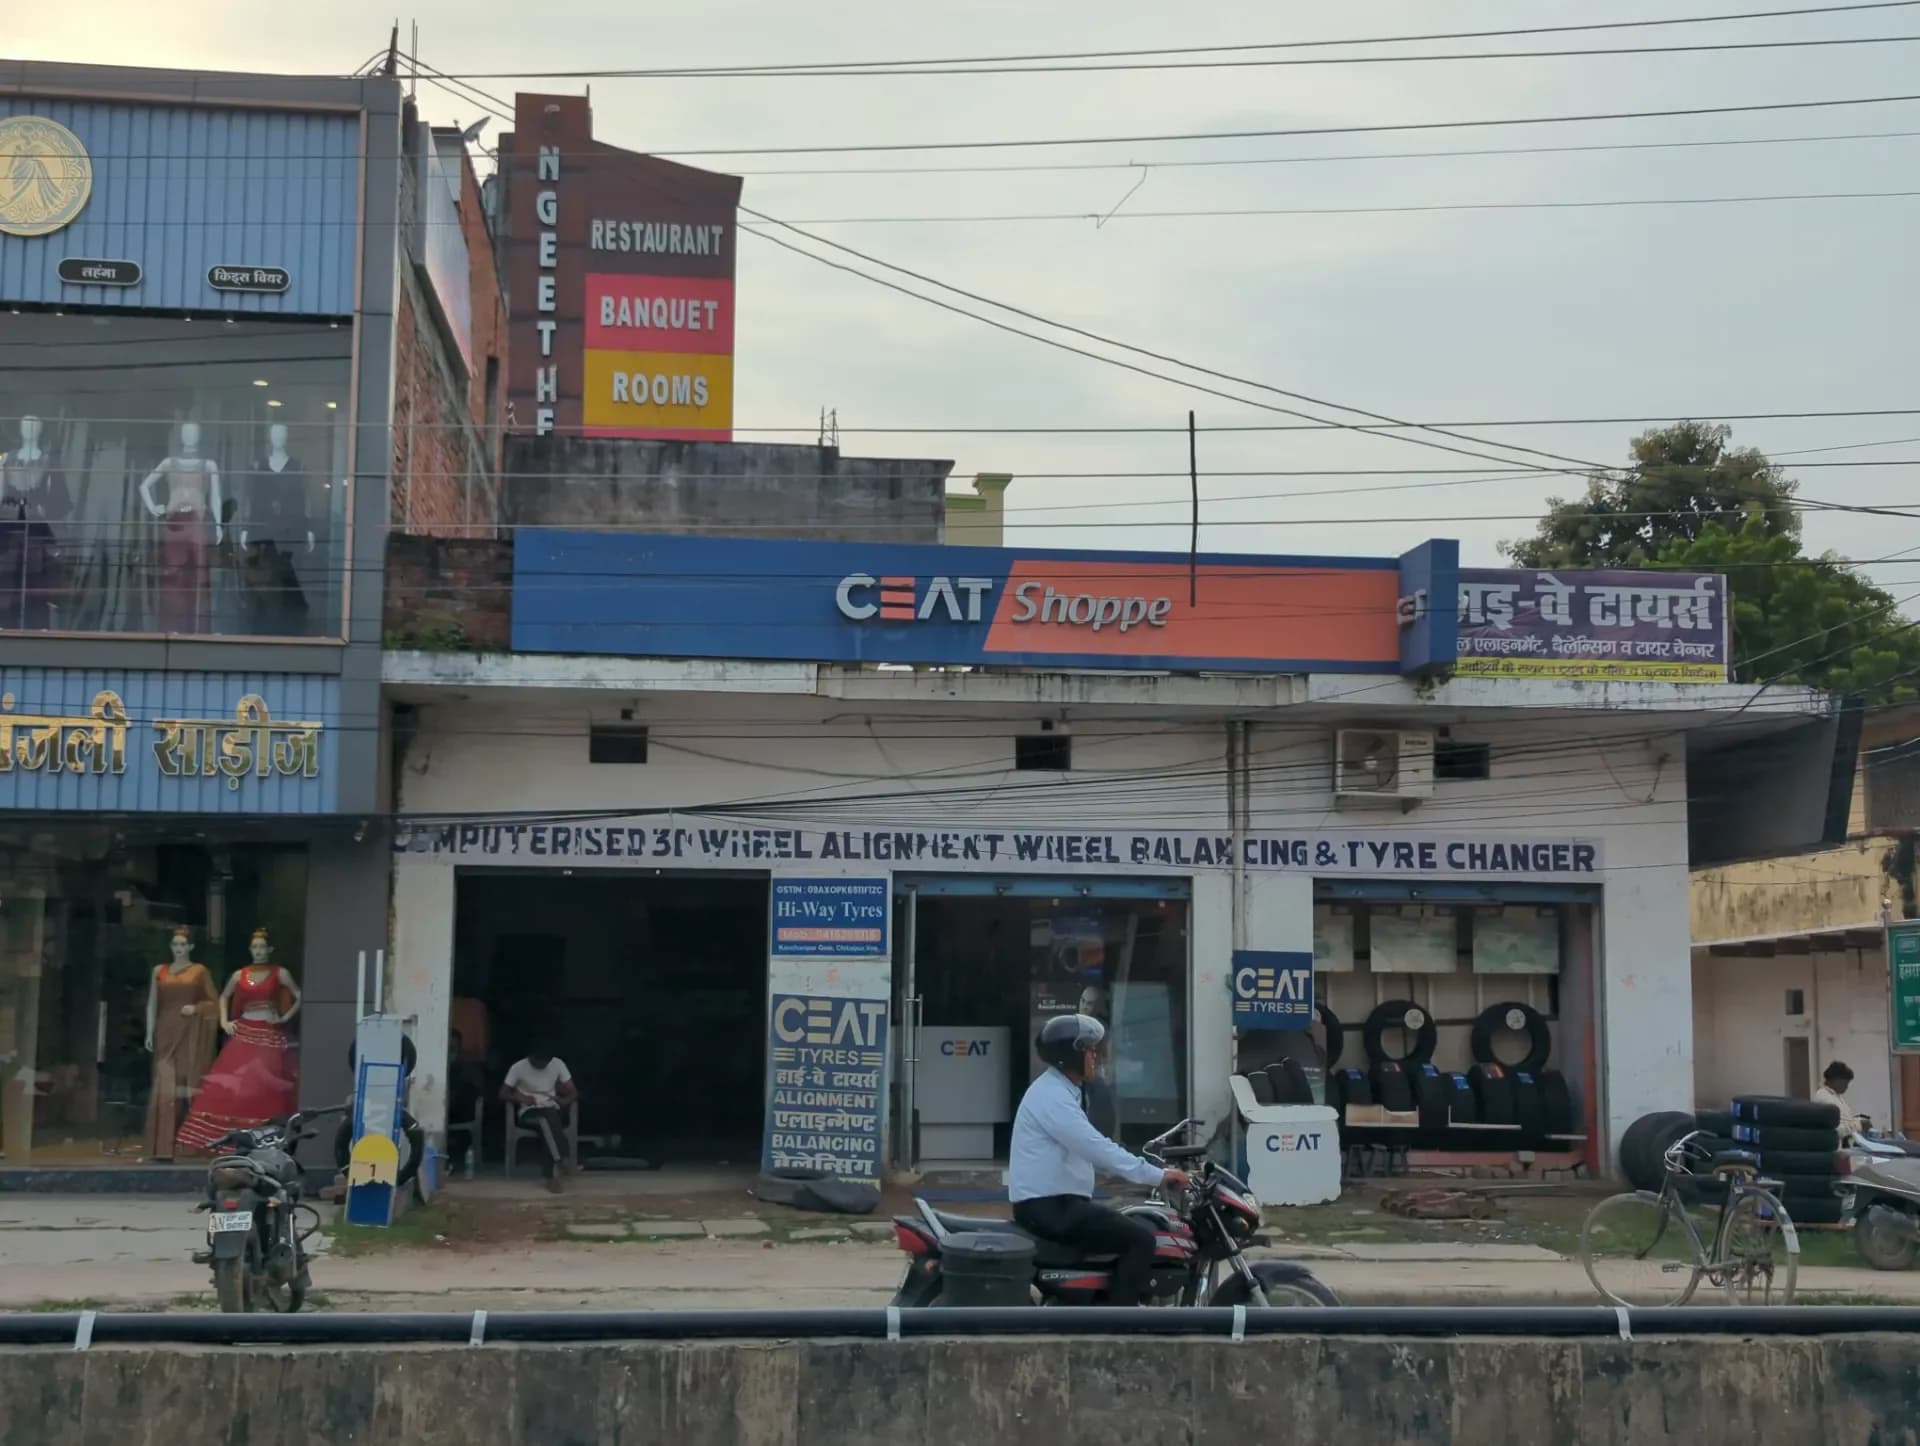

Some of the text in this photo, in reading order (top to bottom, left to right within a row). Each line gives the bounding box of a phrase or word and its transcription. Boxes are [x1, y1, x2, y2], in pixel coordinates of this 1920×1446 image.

[592, 219, 723, 255] RESTAURANT
[600, 295, 718, 331] BANQUET
[612, 371, 709, 407] ROOMS
[836, 572, 1171, 632] CEAT Shoppe
[1635, 641, 1672, 656] टायर
[152, 694, 324, 791] साड़ीज
[1012, 834, 1121, 864] WHEEL
[1130, 836, 1309, 866] BALANCING
[1314, 841, 1338, 866] &
[1345, 841, 1437, 869] TYRE
[1446, 843, 1596, 873] CHANGER
[777, 901, 883, 923] Hi-Way Tyres
[1236, 967, 1311, 1000] CEAT
[1252, 1002, 1293, 1014] TYRES
[774, 998, 888, 1047] CEAT
[798, 1048, 860, 1066] TYRES
[940, 1040, 991, 1057] CEAT
[774, 1090, 878, 1109] ALIGNMENT
[772, 1133, 876, 1153] BALANCING
[1266, 1134, 1321, 1152] CEAT
